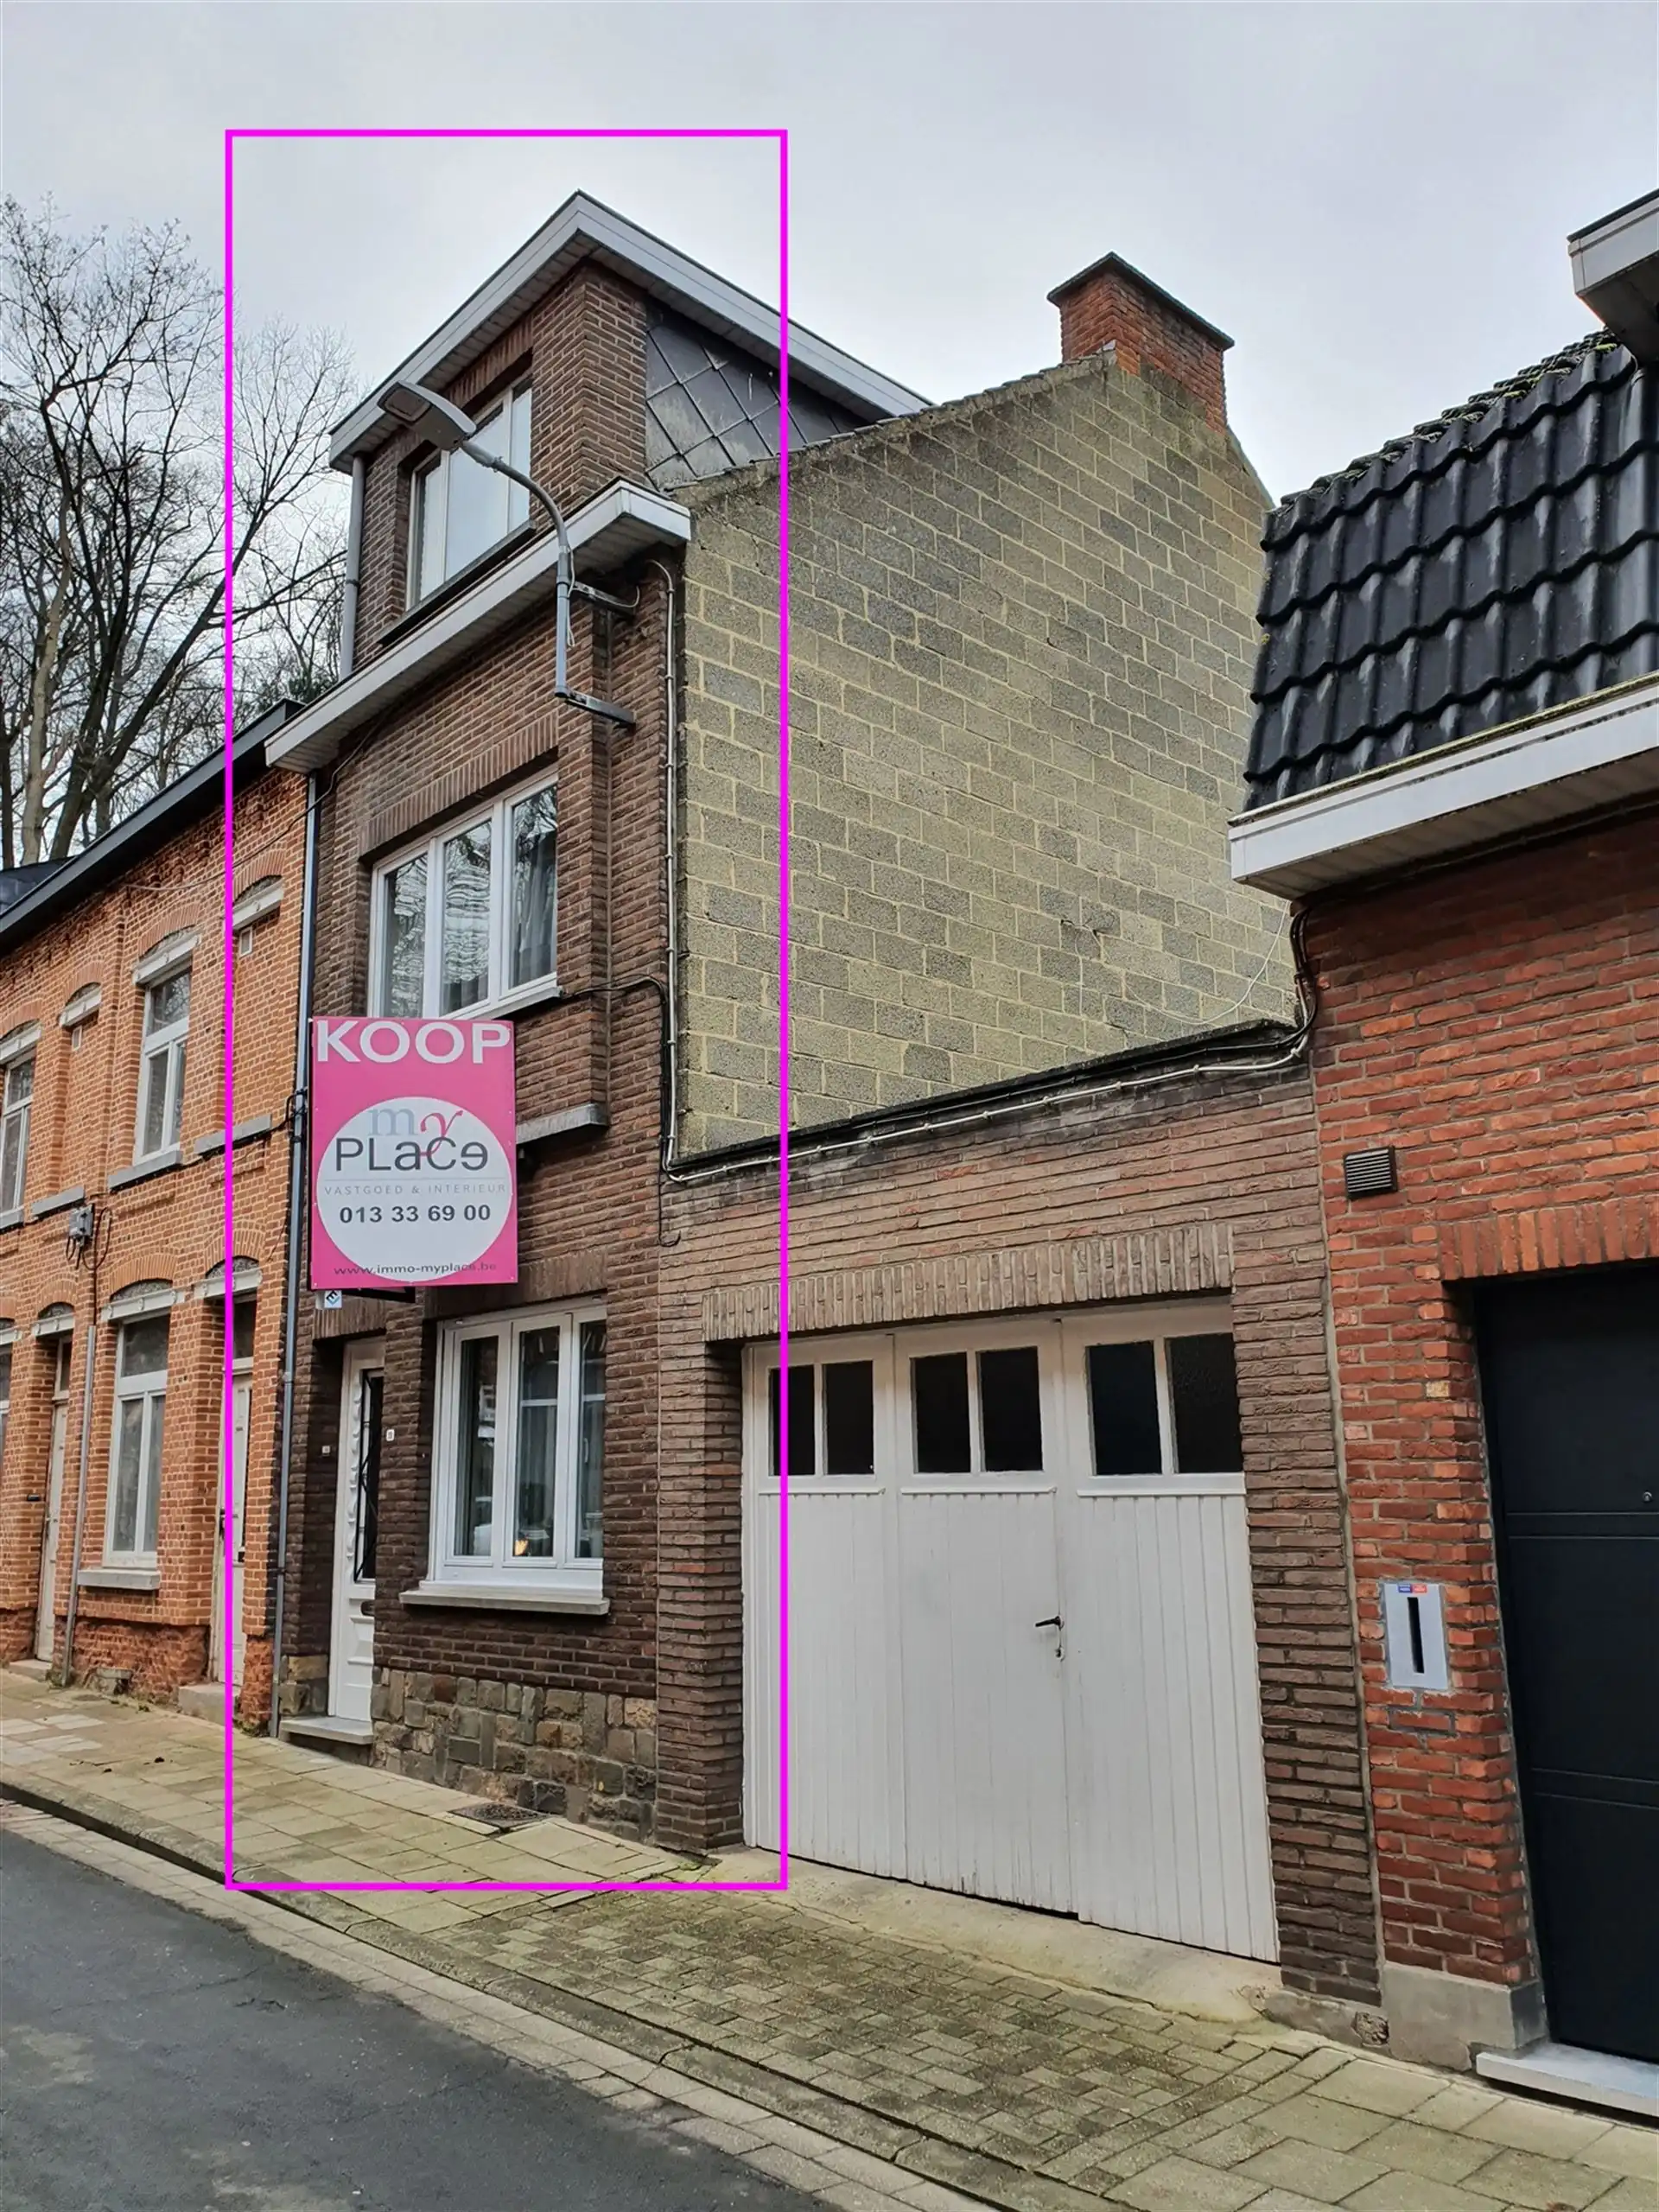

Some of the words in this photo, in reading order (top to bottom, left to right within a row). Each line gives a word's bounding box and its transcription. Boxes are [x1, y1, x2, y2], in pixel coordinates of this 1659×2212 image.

[317, 1020, 511, 1064] KOOP
[366, 1106, 464, 1156] my
[324, 1185, 404, 1196] VASTGOED
[429, 1184, 506, 1195] INTERIEUR
[340, 1206, 383, 1224] 013
[391, 1205, 419, 1223] 33
[428, 1205, 455, 1222] 69
[463, 1204, 491, 1221] 00
[334, 1262, 497, 1275] www.immo-myplace.be
